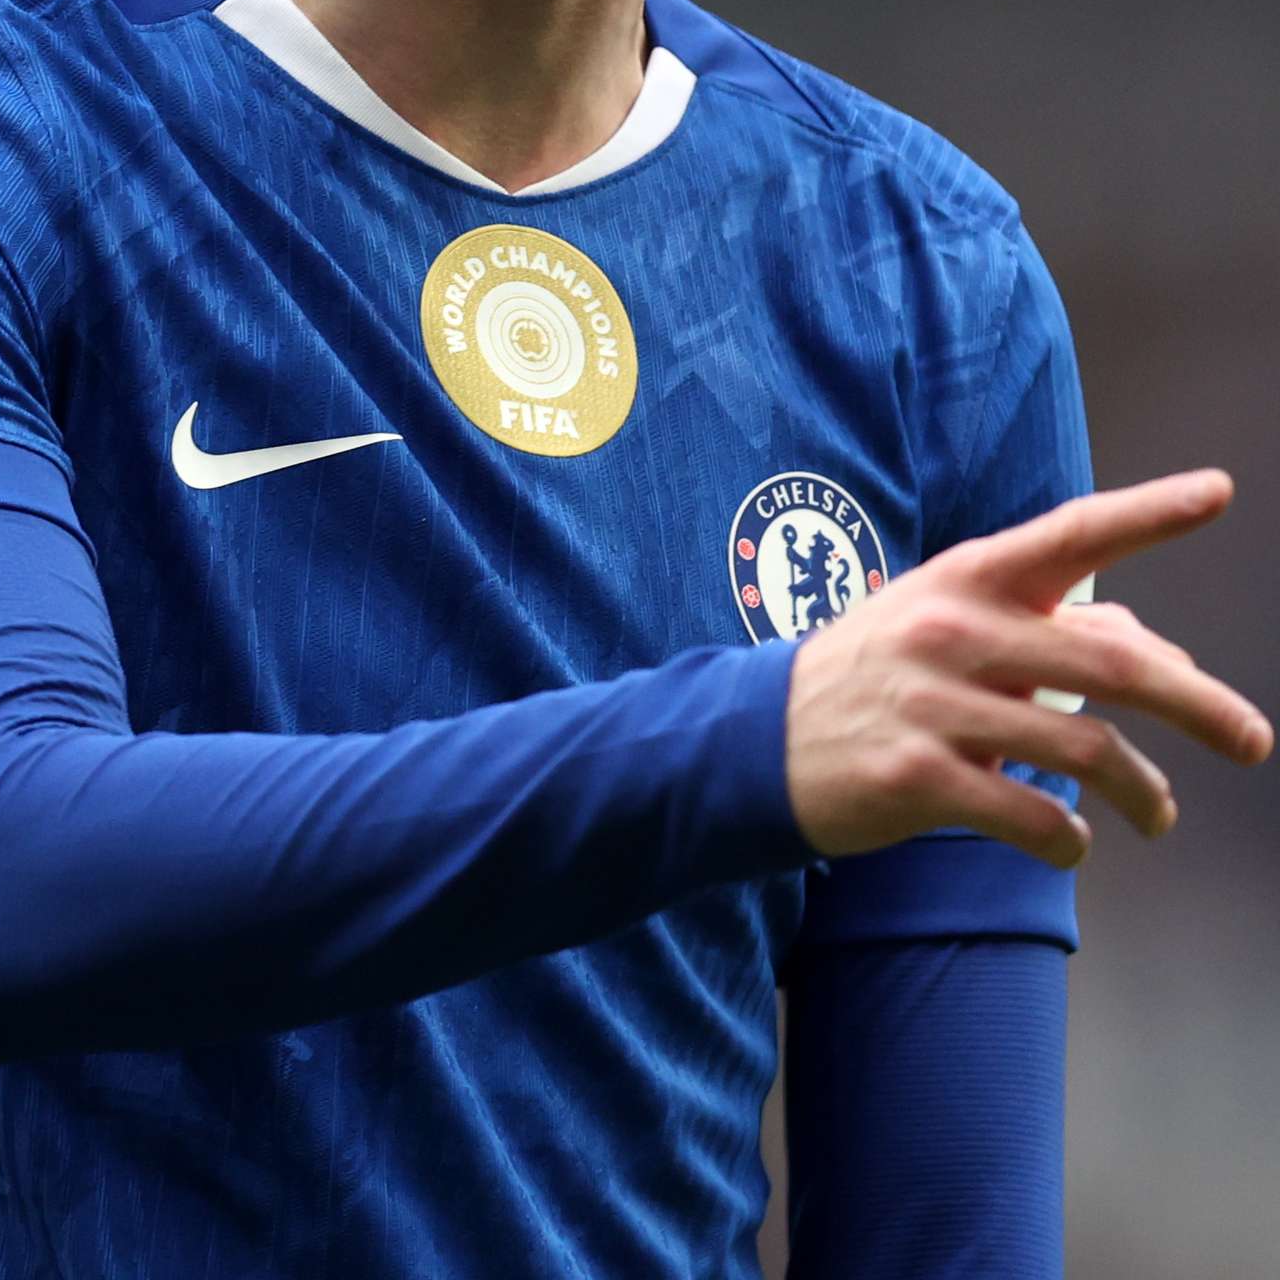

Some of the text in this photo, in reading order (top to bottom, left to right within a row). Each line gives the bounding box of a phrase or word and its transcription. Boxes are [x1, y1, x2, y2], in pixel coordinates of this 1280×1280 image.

[442, 246, 619, 379] WORLD CHAMPIONS
[499, 400, 580, 440] FIFA
[756, 482, 863, 541] CHELSEA
